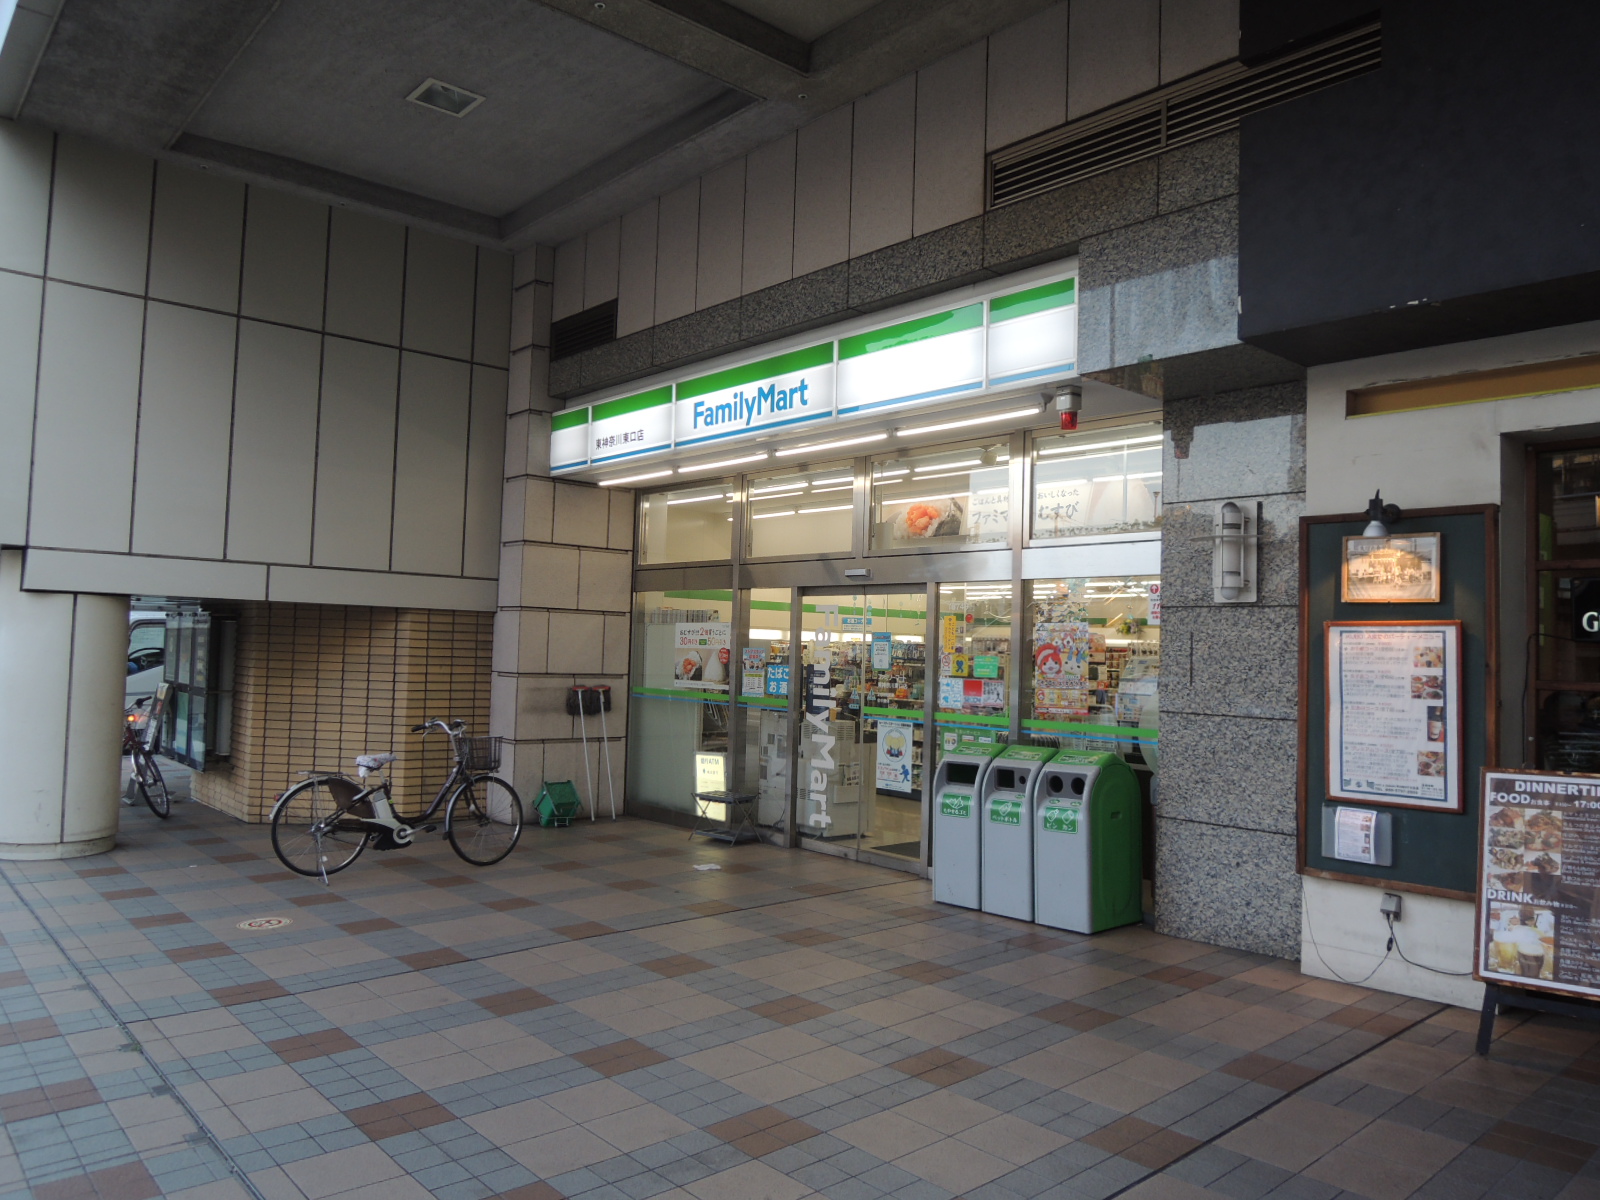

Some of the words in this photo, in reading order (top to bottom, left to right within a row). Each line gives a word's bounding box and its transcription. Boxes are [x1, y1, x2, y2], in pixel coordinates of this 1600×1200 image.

[693, 378, 808, 427] FamilyMart
[595, 429, 645, 450] 東神奈川東口店
[1037, 488, 1080, 500] おいしくなった
[1037, 501, 1080, 521] むすび
[1582, 611, 1600, 633] G
[767, 666, 789, 679] たばこ
[769, 681, 788, 693] お酒
[806, 604, 839, 828] FamilyMart
[1489, 791, 1531, 804] FOOD
[1487, 889, 1533, 904] DRINK
